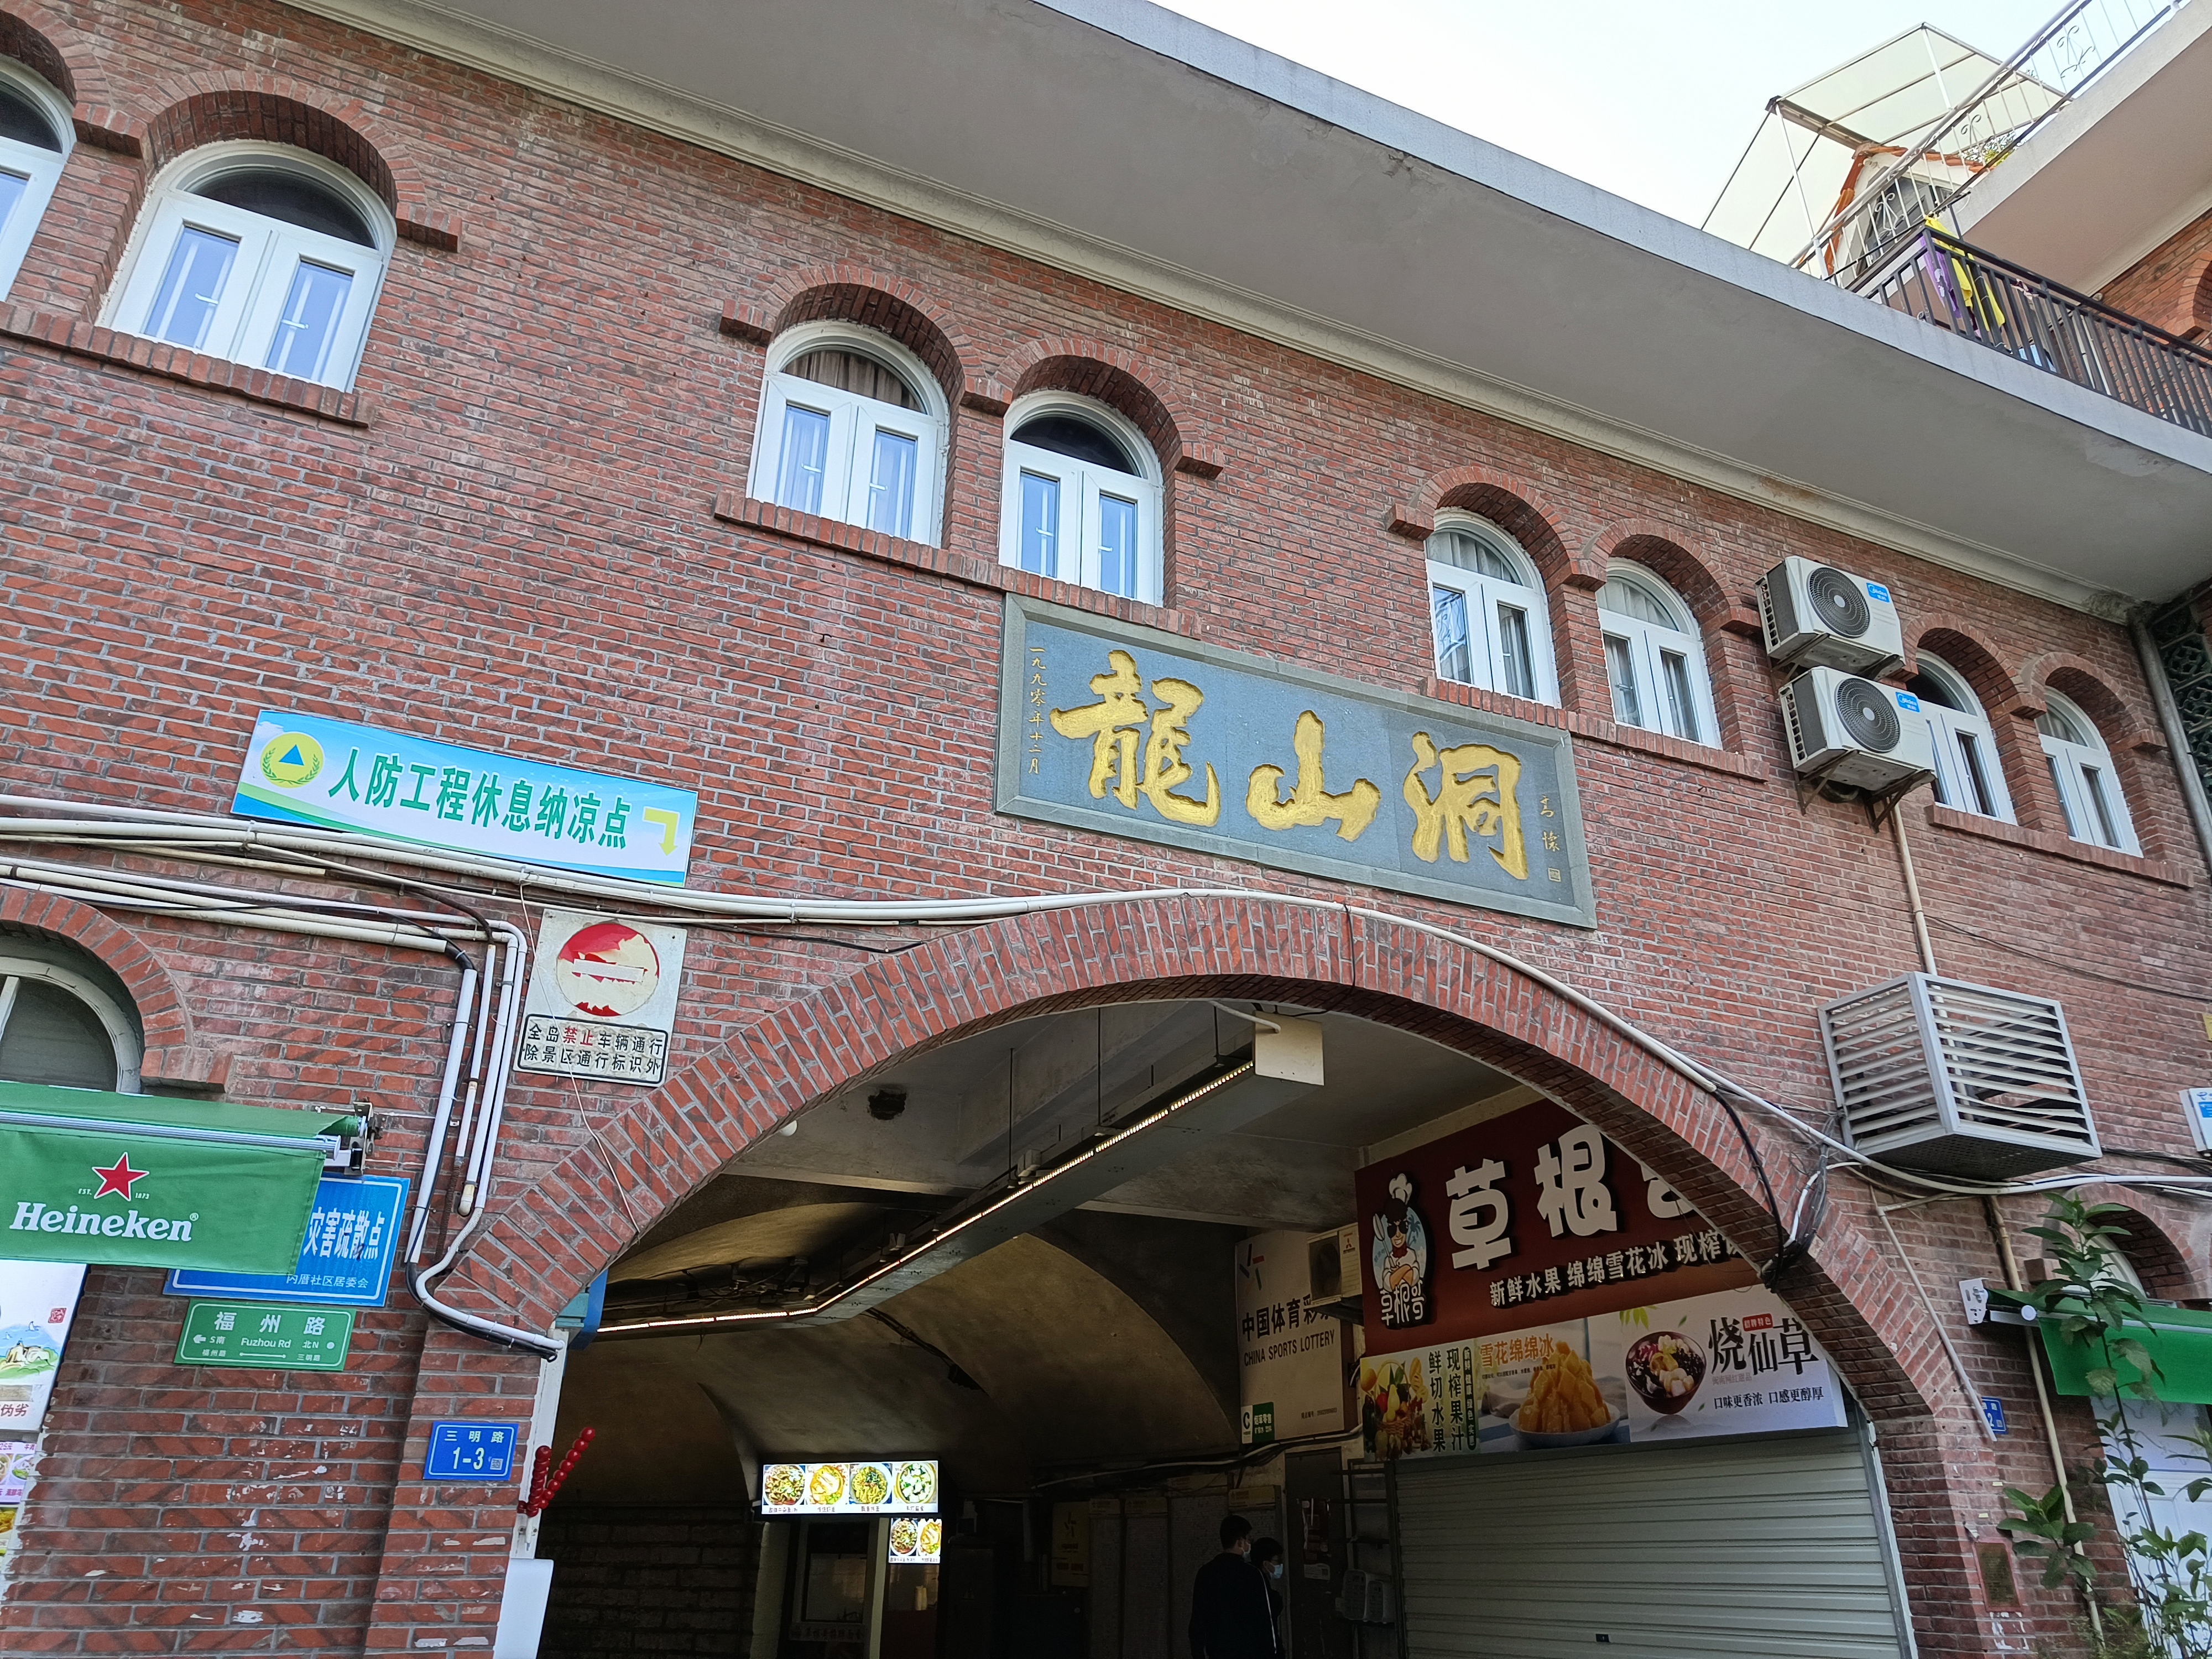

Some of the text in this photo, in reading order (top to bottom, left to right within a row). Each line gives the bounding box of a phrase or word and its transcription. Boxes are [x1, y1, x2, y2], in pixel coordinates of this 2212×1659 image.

[1028, 647, 1047, 774] 一九九零年十二月
[1050, 649, 1529, 880] 龍山洞
[328, 748, 631, 850] 人防工程休息纳凉点
[524, 1043, 661, 1075] 除景区通行标识外
[528, 1023, 663, 1056] 全岛禁止车辆通行
[9, 1202, 192, 1241] Heineken
[302, 1206, 385, 1260] 灾害疏散点
[1489, 1266, 1561, 1306] 新鲜水果
[1567, 1241, 1669, 1287] 绵绵雪花冰
[214, 1311, 325, 1335] 福州路
[1242, 1293, 1329, 1342] 中国体育彩
[241, 1337, 292, 1348] Fuzhou Rd
[1244, 1329, 1335, 1366] CHINA SPORTS LOTTERY
[1480, 1333, 1555, 1368] 雪花绵绵冰
[1708, 1317, 1819, 1375] 烧仙草
[1428, 1350, 1446, 1453] 鲜切水果
[1446, 1347, 1464, 1451] 现榨果汁
[1714, 1386, 1824, 1410] 口味更香浓 口感更醇厚
[444, 1430, 504, 1443] 三明路
[453, 1447, 484, 1470] 1-3
